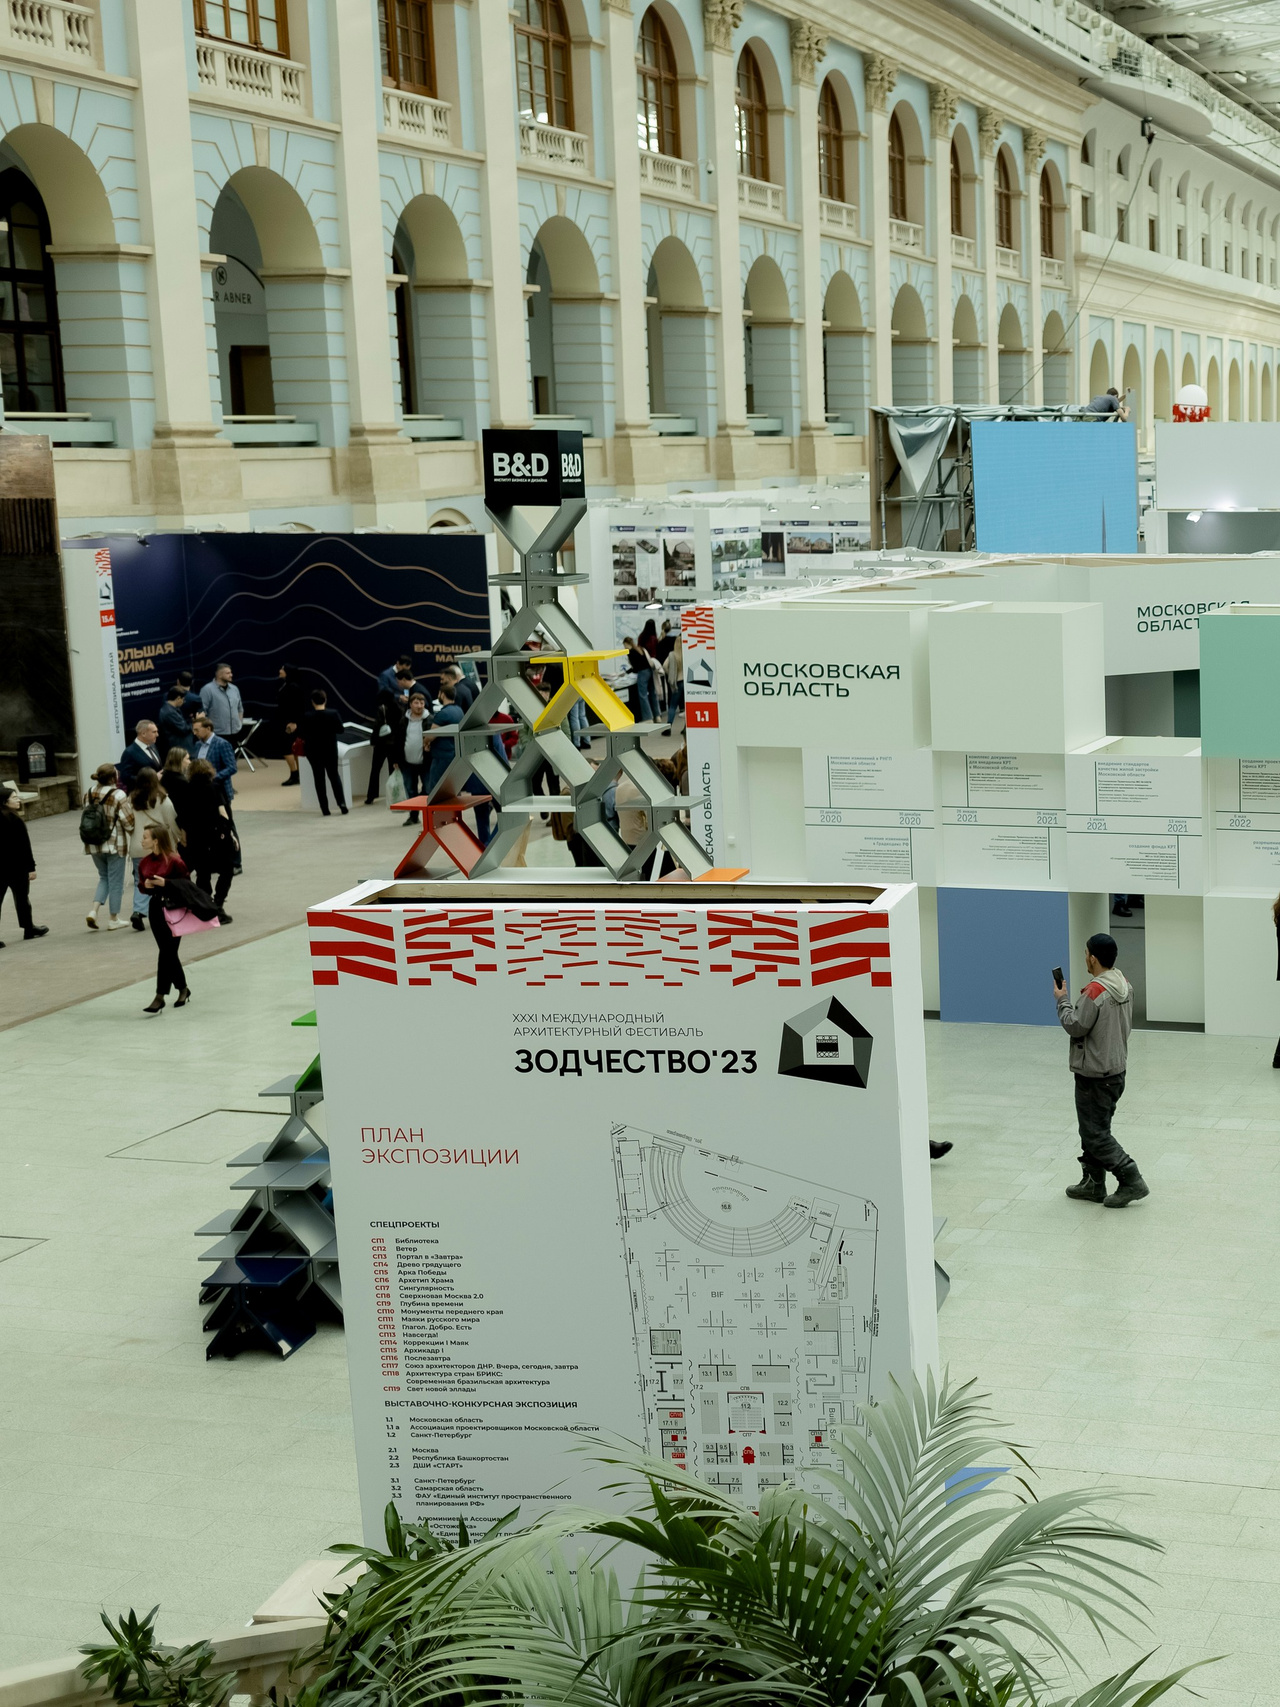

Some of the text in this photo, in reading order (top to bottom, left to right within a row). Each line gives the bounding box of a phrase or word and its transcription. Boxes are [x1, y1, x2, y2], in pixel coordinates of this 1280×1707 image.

[224, 292, 252, 304] ABNER
[493, 453, 549, 477] B&D
[561, 453, 581, 477] B&D
[1138, 618, 1200, 633] ОБЛАСТ
[118, 642, 175, 661] ОЛЬШАЯ
[414, 644, 481, 653] БОЛЬШАЯ
[119, 658, 155, 674] АЙМА
[744, 663, 900, 680] МОСКОВСКАЯ
[744, 682, 849, 697] ОБЛАСТЬ
[695, 711, 709, 722] 1.1
[702, 762, 712, 820] ОБАСТЬ
[820, 815, 842, 823] 2020
[899, 817, 921, 825] 2020
[957, 814, 978, 822] 2021
[1037, 816, 1058, 824] 2021
[1229, 819, 1251, 827] 2022
[1087, 822, 1107, 830] 2021
[1168, 824, 1188, 832] 2021
[512, 1012, 664, 1025] XXXI МЕЖДУНАРОДНЫЙ
[514, 1025, 704, 1037] АРХИТЕКТУРНЫЙ ФЕСТИВАЛЬ
[515, 1049, 757, 1076] ЗОДЧЕСТВО'23
[361, 1127, 424, 1143] ПЛАН
[362, 1148, 519, 1166] ЭКСПОЗИЦИИ
